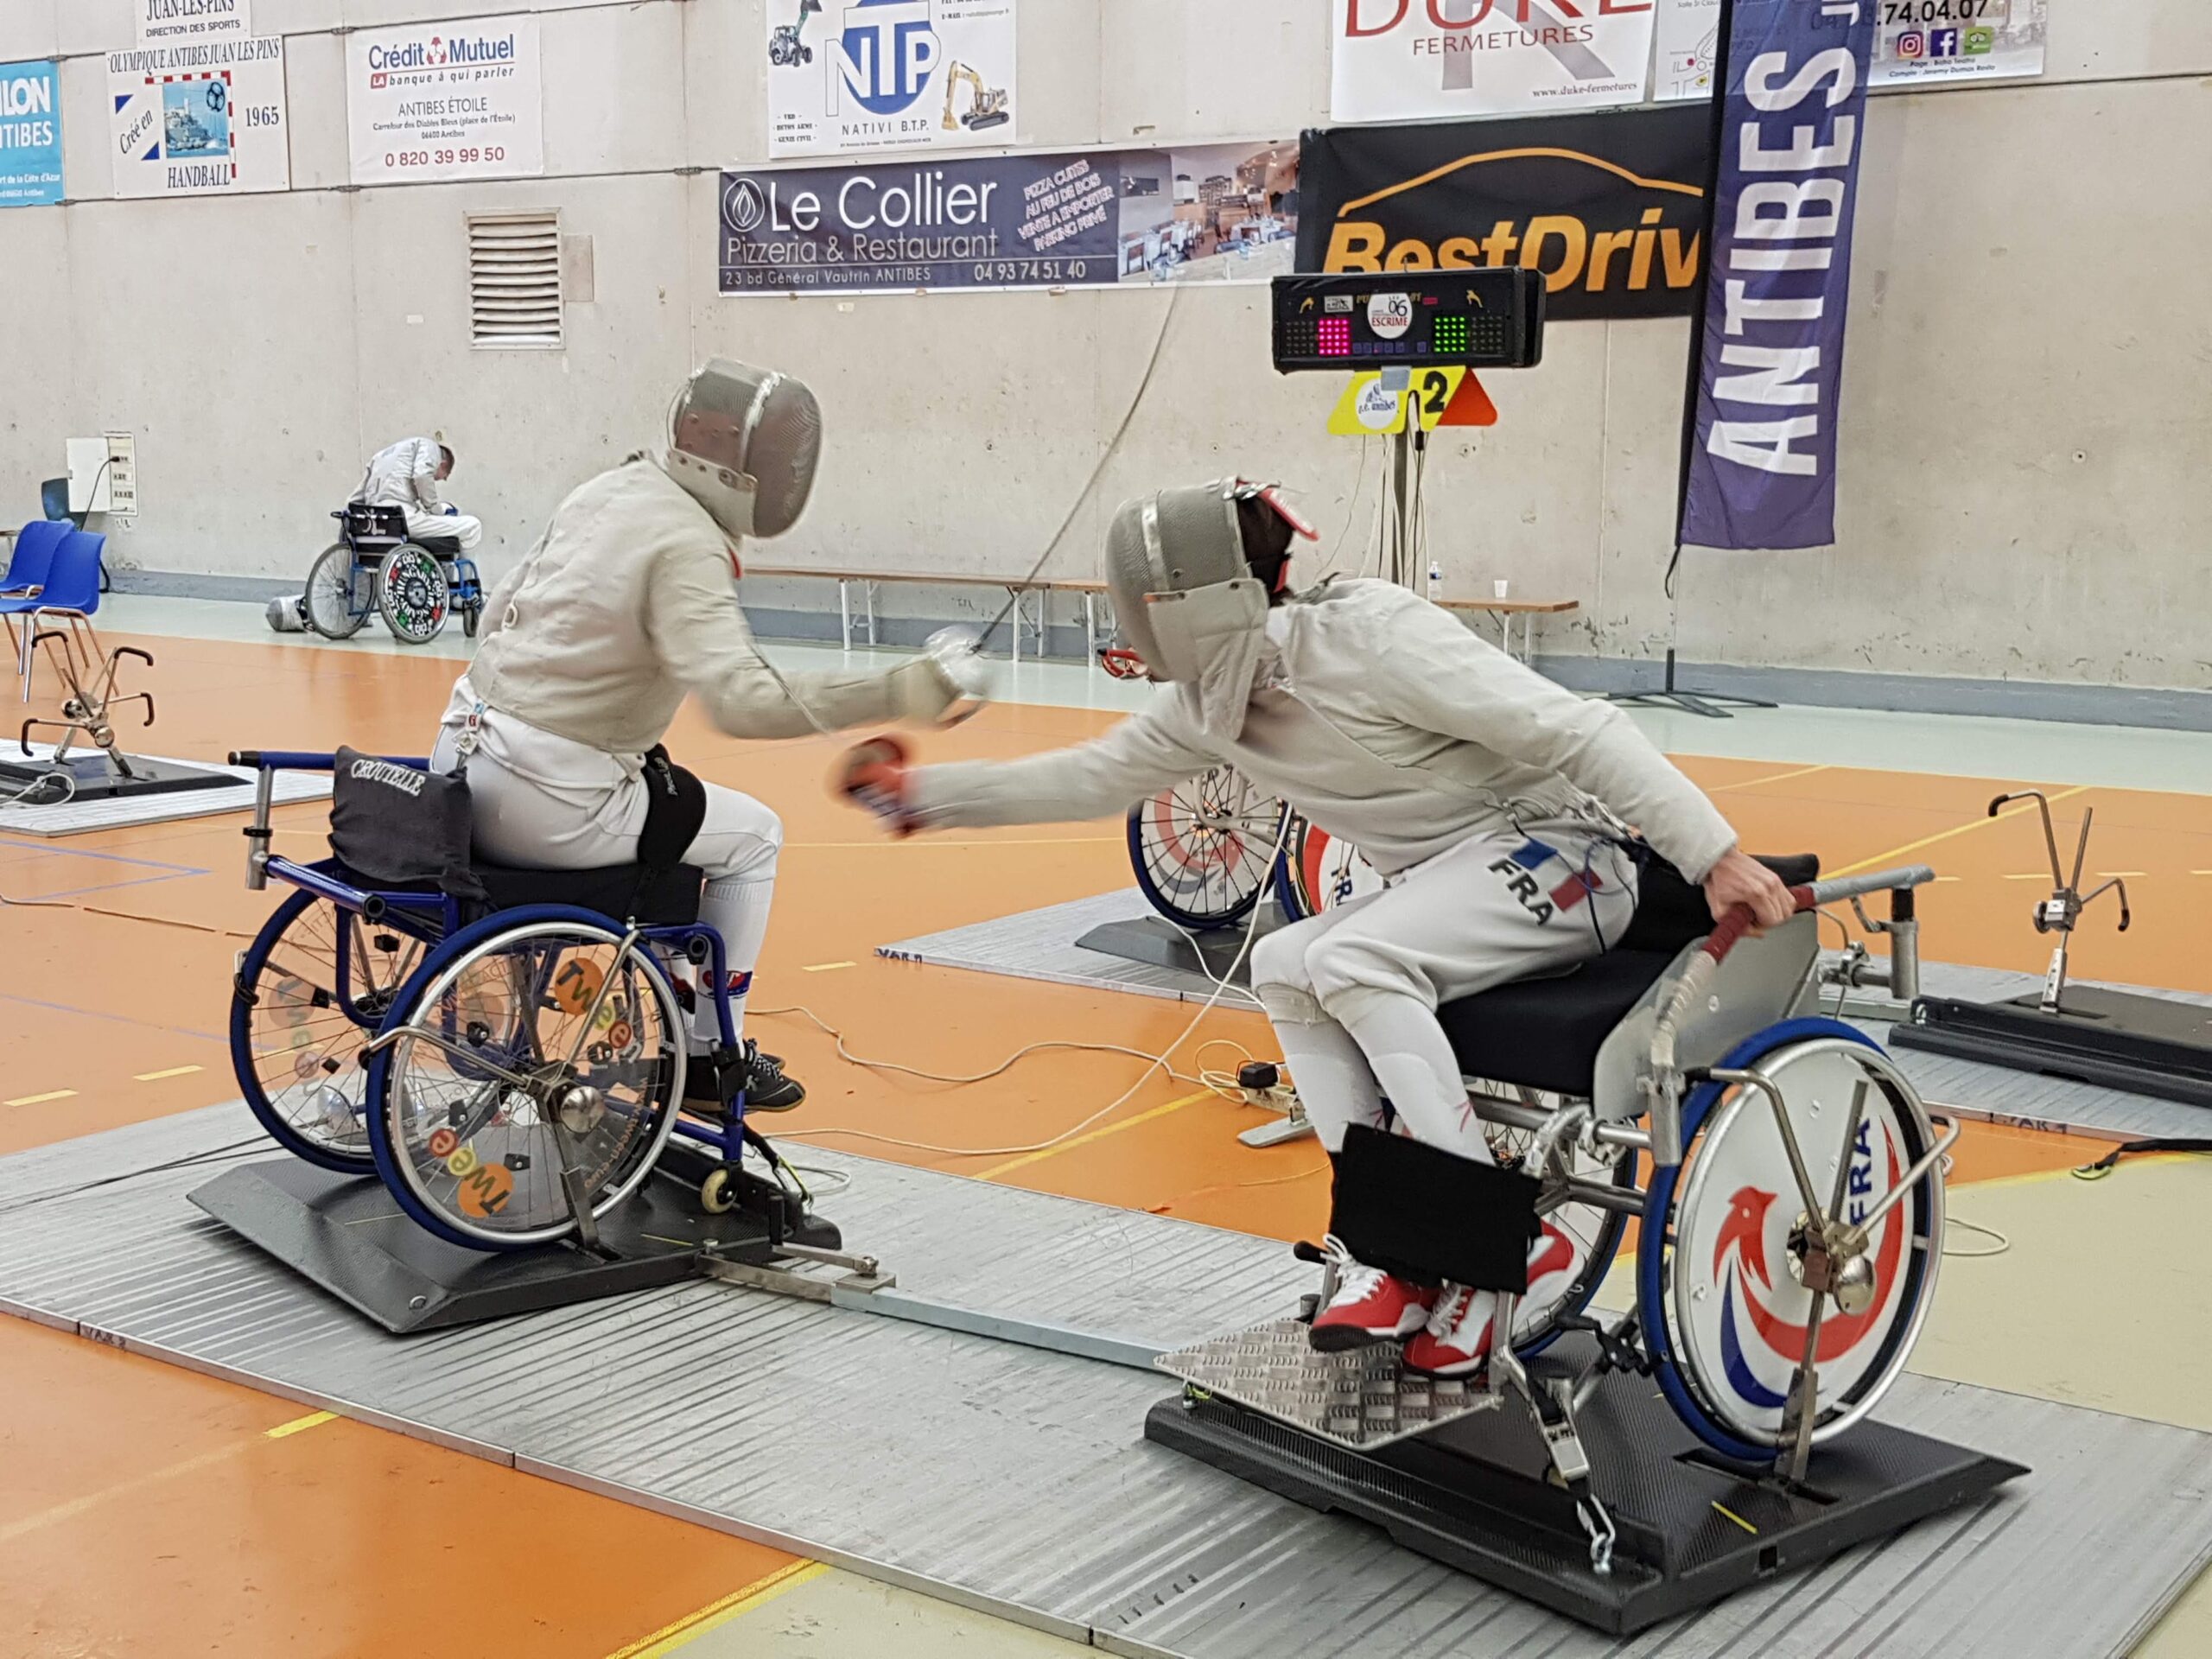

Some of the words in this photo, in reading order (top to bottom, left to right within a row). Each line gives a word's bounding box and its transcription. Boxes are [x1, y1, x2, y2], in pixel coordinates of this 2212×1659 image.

[146, 25, 188, 37] DIRECTION
[189, 22, 206, 33] DES
[208, 19, 240, 31] SPORTS
[1413, 24, 1593, 55] FERMETURES
[168, 44, 207, 67] ANTIBES
[209, 41, 237, 64] JUAN
[238, 40, 254, 60] LES
[369, 42, 424, 70] Crédit
[449, 34, 514, 63] Mutuel
[825, 1, 941, 117] NTP
[372, 76, 385, 86] LA
[390, 74, 432, 86] banque
[439, 71, 444, 81] à
[450, 69, 469, 83] qui
[475, 67, 514, 81] parler
[0, 76, 50, 117] LON
[398, 99, 445, 117] ANTIBES
[448, 96, 487, 113] ÉTOILE
[246, 106, 279, 126] 1965
[842, 122, 892, 136] NATIVI
[901, 119, 930, 131] B.T.P.
[0, 121, 53, 149] TIBES
[120, 118, 140, 154] Créé
[141, 110, 153, 130] en
[385, 153, 394, 167] 0
[399, 151, 428, 166] 820
[435, 149, 454, 164] 39
[460, 149, 479, 162] 99
[485, 147, 505, 161] 50
[168, 164, 230, 188] HANDBALL
[771, 181, 820, 232] Le
[839, 171, 997, 229] Collier
[1026, 200, 1041, 219] AU
[728, 235, 817, 264] Pizzeria
[827, 236, 844, 262] &
[853, 228, 997, 260] Restaurant
[726, 270, 742, 285] 23
[747, 270, 762, 283] bd
[768, 270, 818, 283] Général
[824, 269, 870, 283] Vautrin
[875, 267, 931, 282] ANTIBES
[975, 264, 994, 281] 04
[996, 264, 1016, 280] 93
[1020, 263, 1038, 280] 74
[1043, 262, 1061, 279] 51
[1067, 261, 1085, 278] 40
[1707, 48, 1857, 475] ANTIBES
[1389, 300, 1408, 316] 06
[1372, 317, 1408, 327] ESCRIME
[1424, 371, 1447, 413] 2
[1332, 865, 1352, 906] FR
[1488, 858, 1554, 925] FRA
[877, 948, 909, 962] VAR
[1848, 1118, 1872, 1227] FRA
